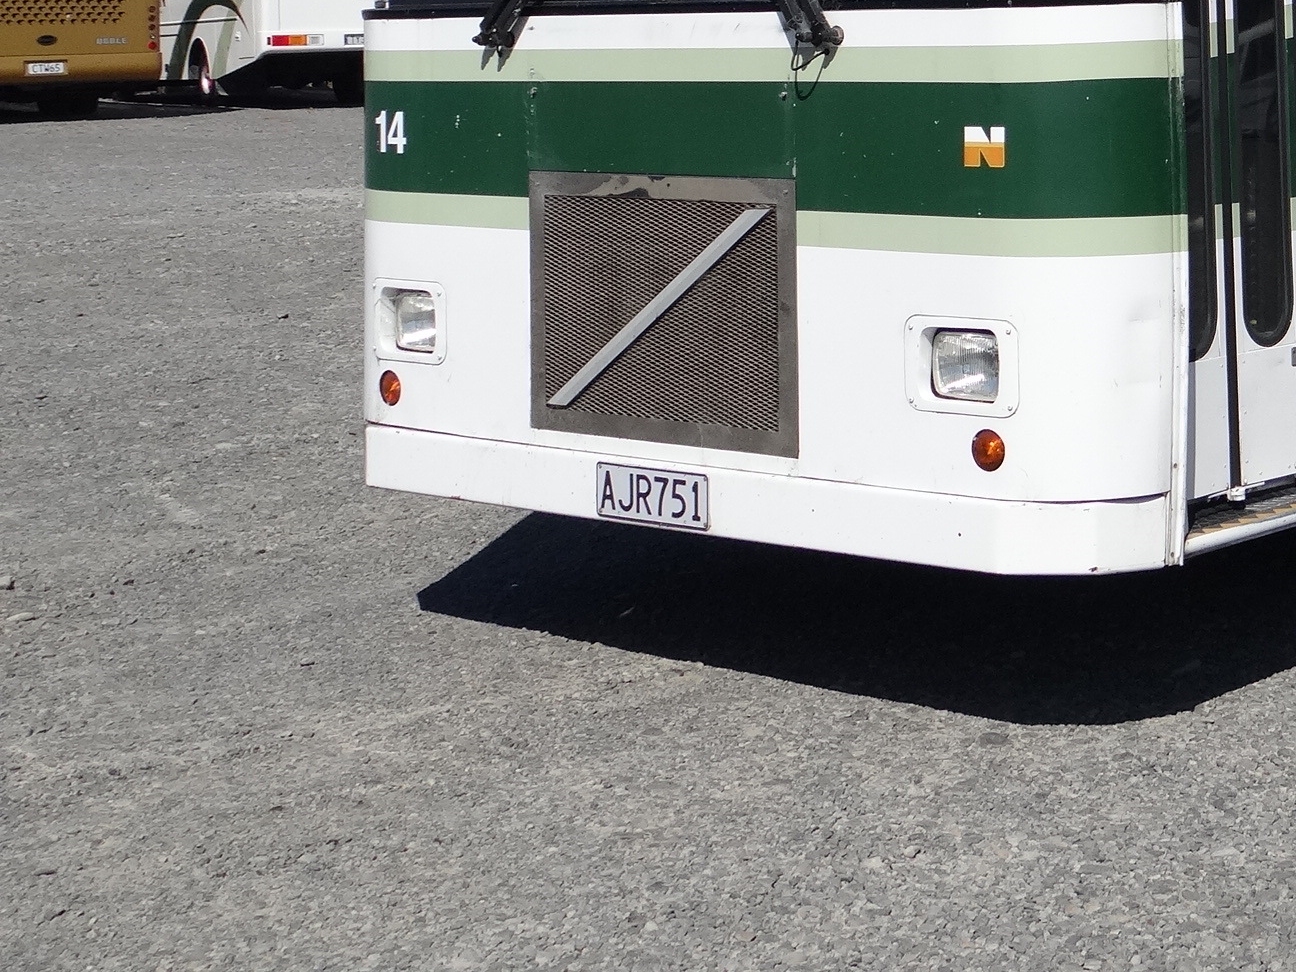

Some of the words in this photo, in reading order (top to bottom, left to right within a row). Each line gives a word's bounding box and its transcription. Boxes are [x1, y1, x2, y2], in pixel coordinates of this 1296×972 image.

[375, 110, 407, 154] 14
[964, 126, 1005, 167] N
[601, 470, 701, 521] AJR751
